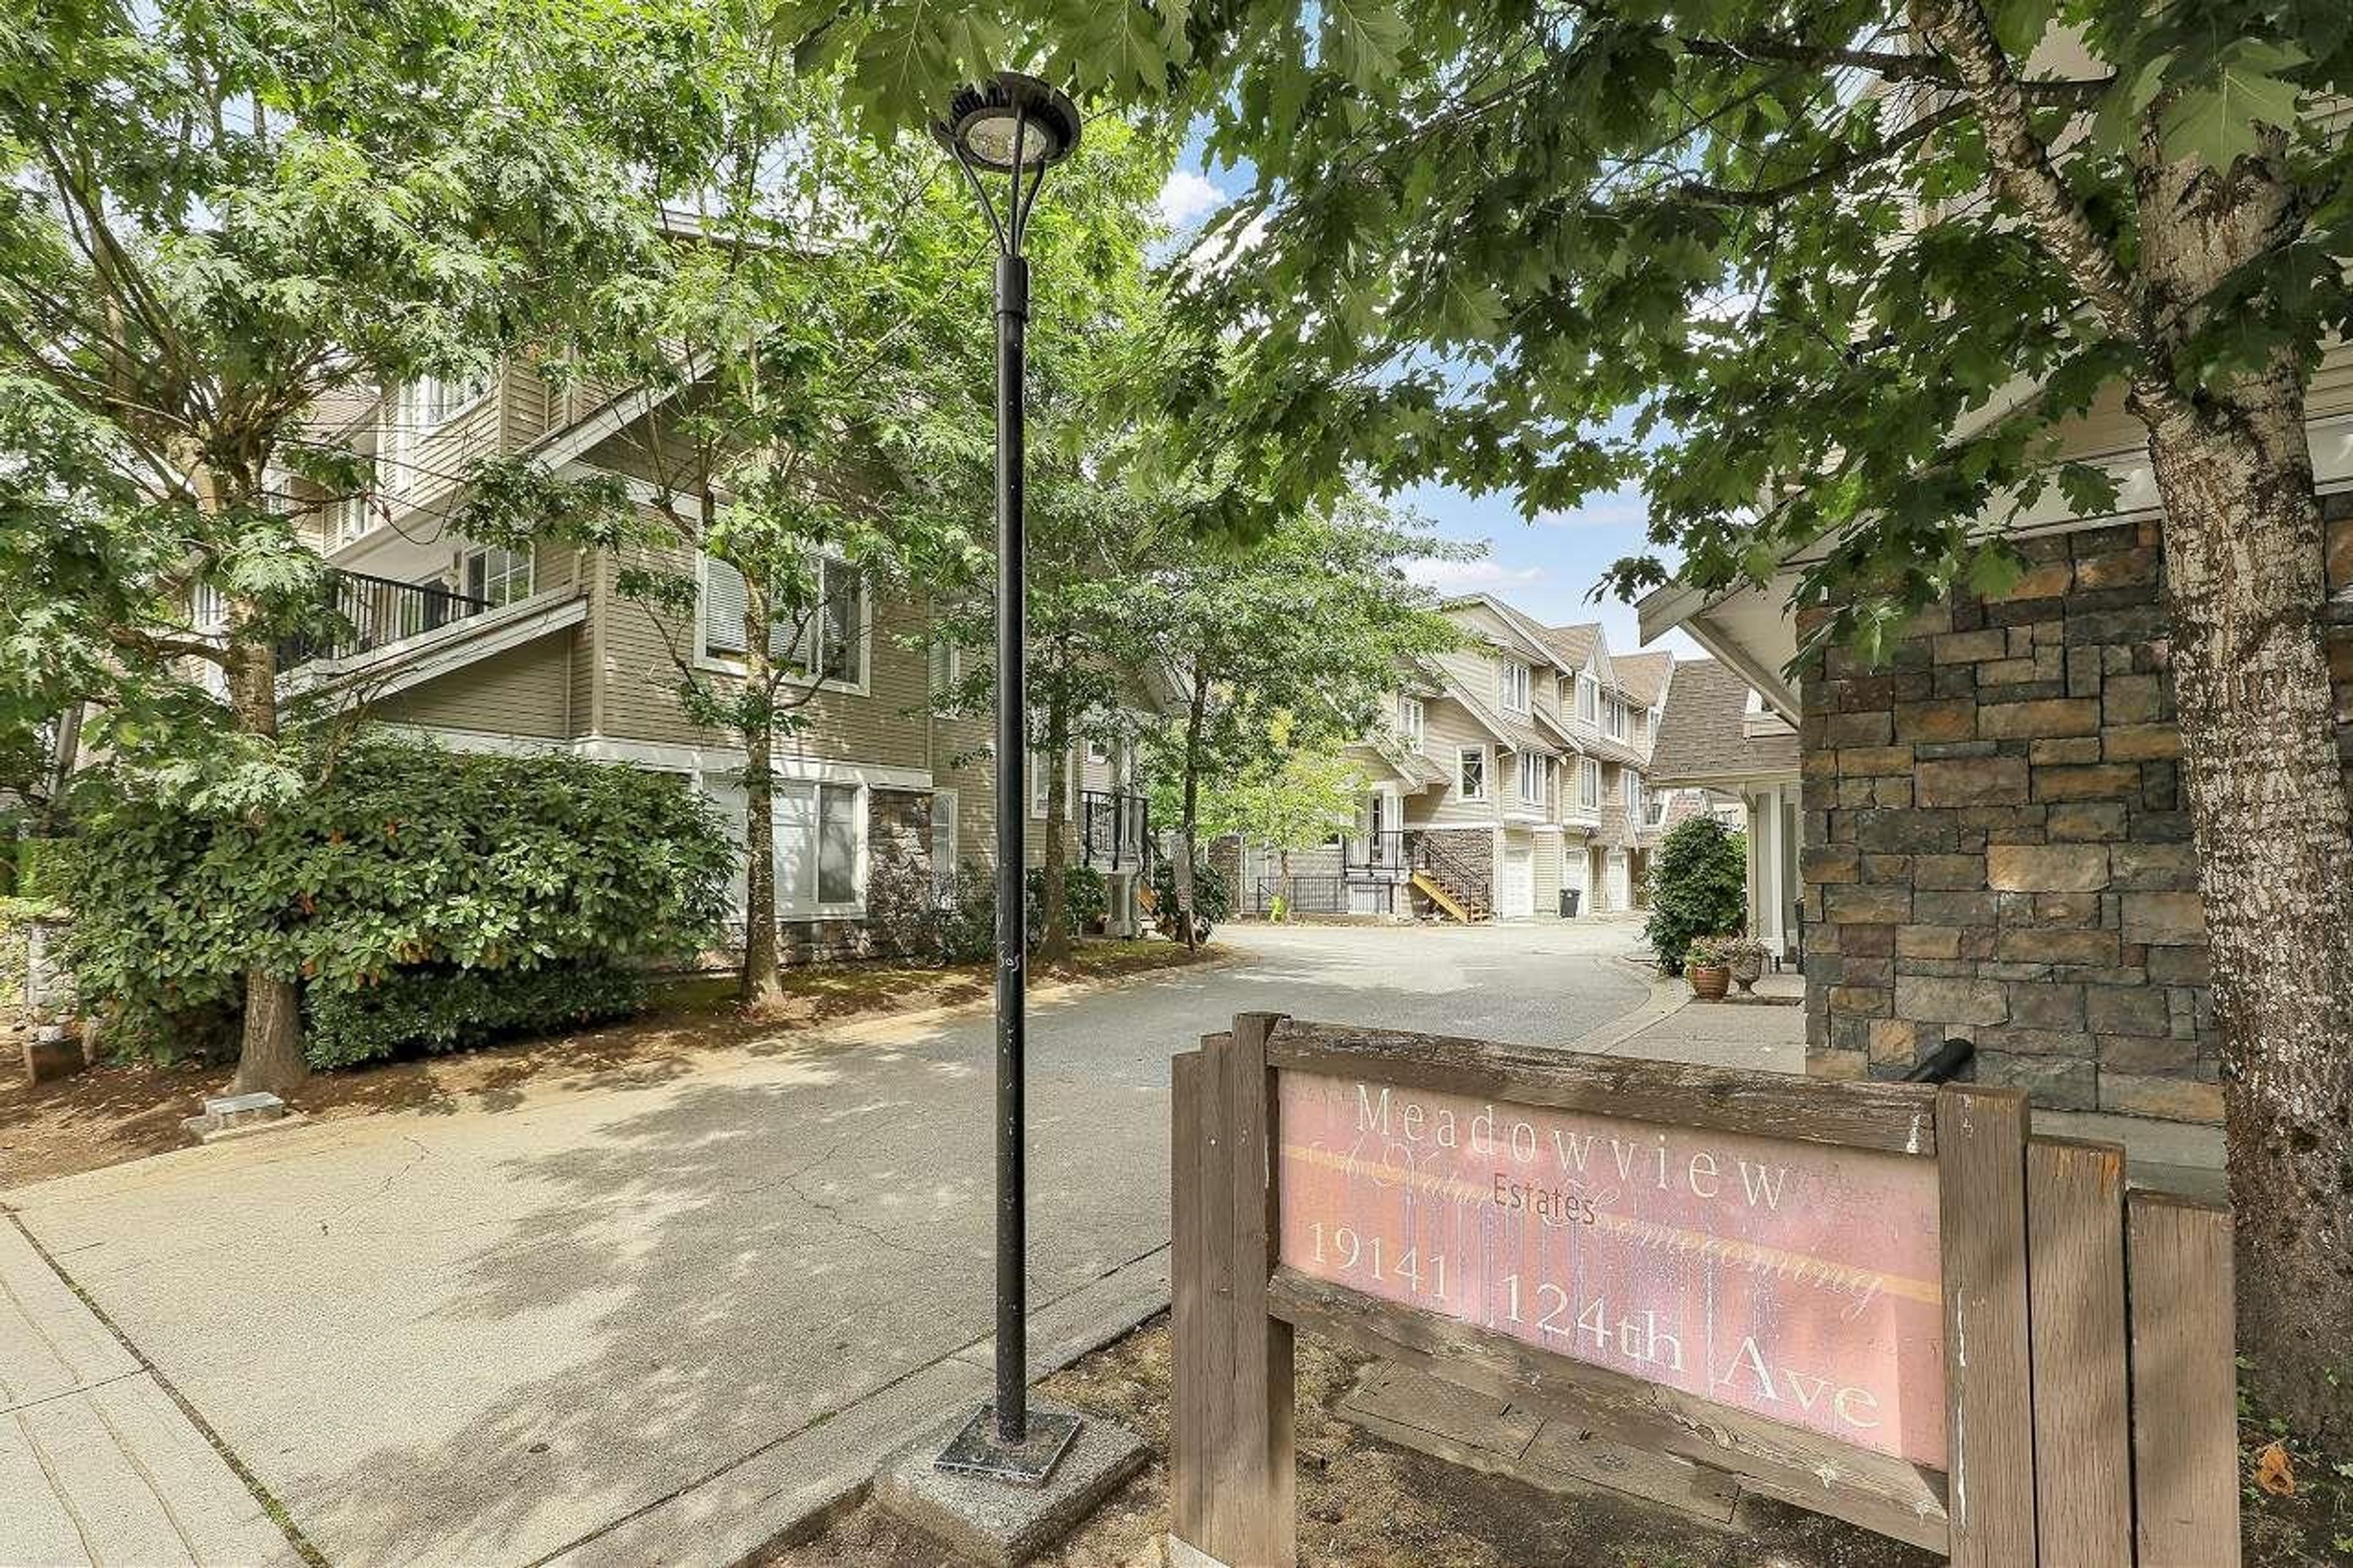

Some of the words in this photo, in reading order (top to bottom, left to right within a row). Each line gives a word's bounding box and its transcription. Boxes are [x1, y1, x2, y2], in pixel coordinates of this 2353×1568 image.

[1356, 1083, 1786, 1211] Meadowview
[1493, 1172, 1596, 1225] Estates
[1308, 1222, 1451, 1300] 19141
[1502, 1273, 1685, 1371] 124th
[1719, 1336, 1882, 1428] Ave
